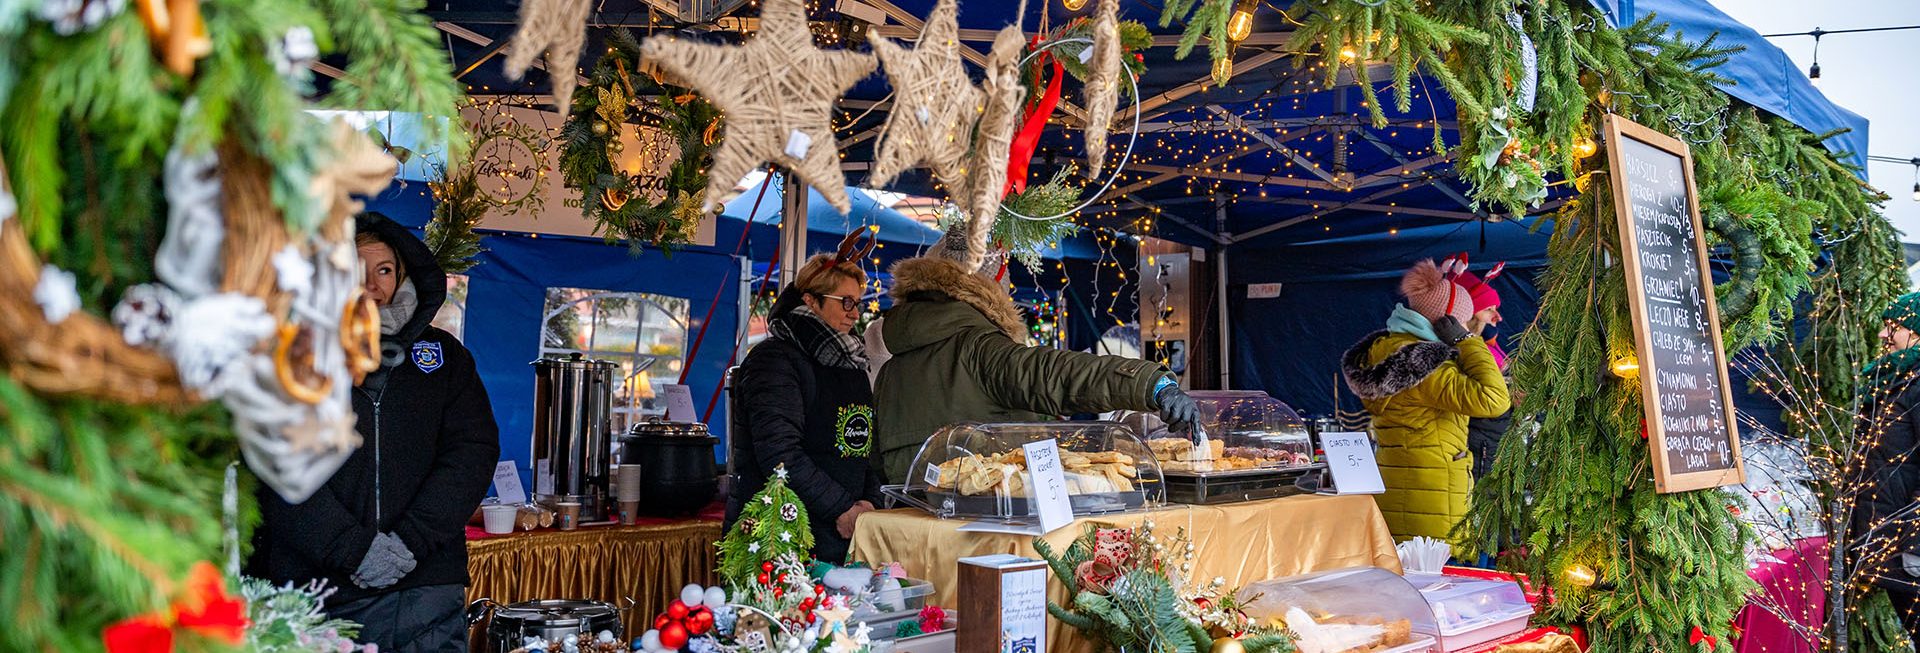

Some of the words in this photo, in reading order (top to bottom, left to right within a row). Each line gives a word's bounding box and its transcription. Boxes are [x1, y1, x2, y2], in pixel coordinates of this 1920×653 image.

[1636, 225, 1673, 247] PASZTECIK
[1641, 249, 1672, 271] KROKIET
[1675, 353, 1694, 366] LCEM
[1657, 368, 1698, 391] CYNAMONKI
[1661, 393, 1687, 413] CIASTO
[1666, 435, 1691, 458] GORĄCA
[1686, 453, 1709, 469] LADA!
